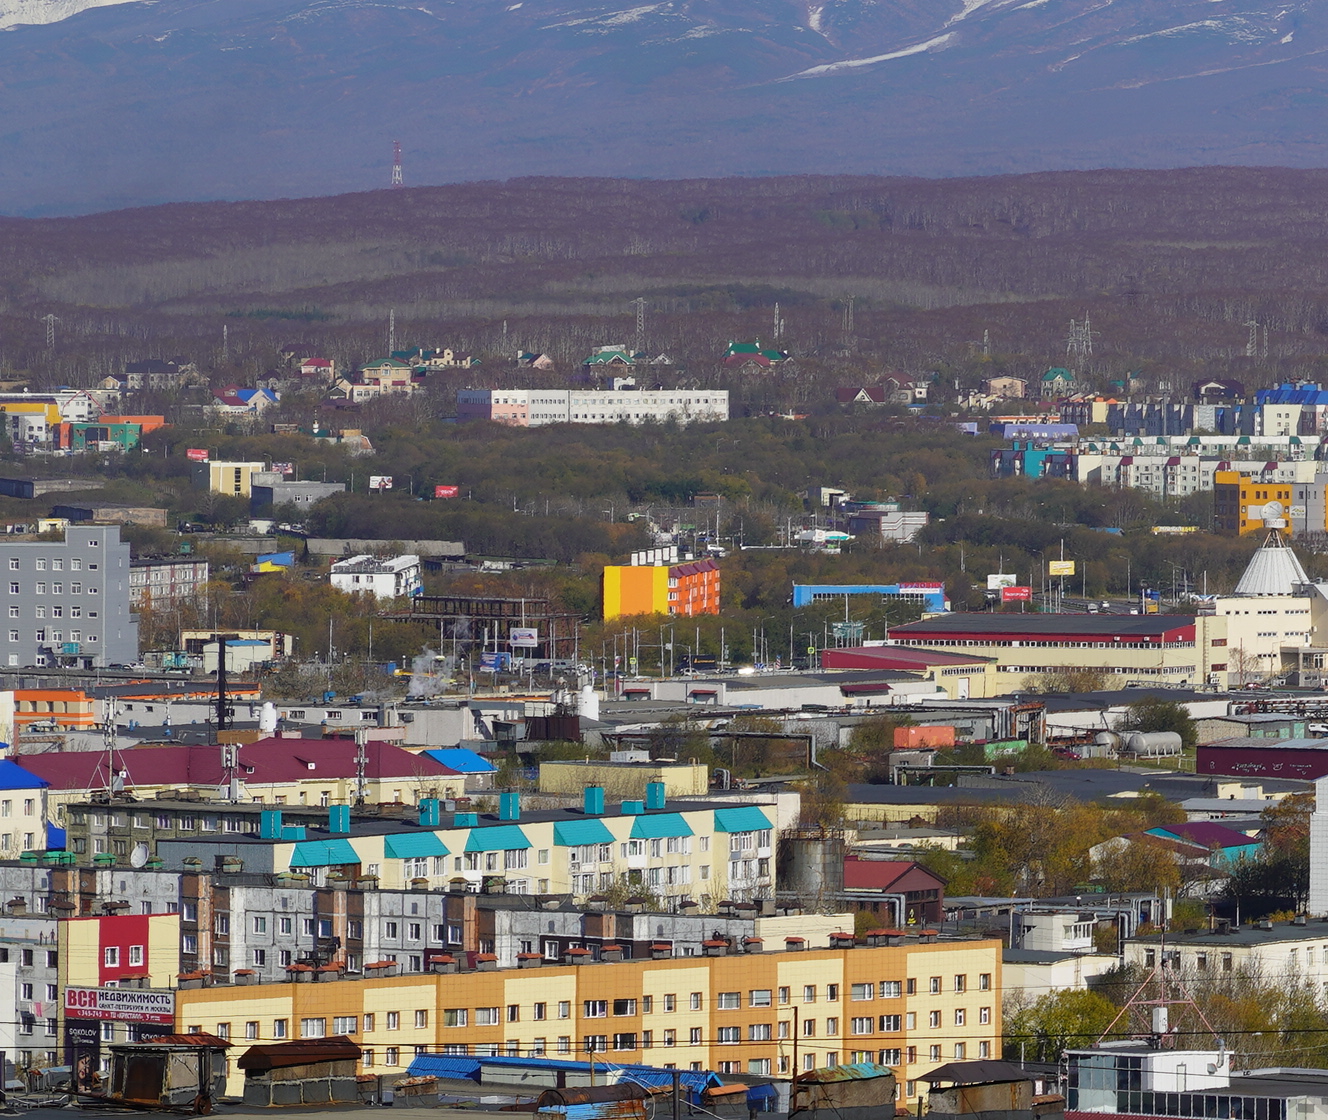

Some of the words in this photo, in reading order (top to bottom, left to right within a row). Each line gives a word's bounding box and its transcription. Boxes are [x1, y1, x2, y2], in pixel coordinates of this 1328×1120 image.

[67, 989, 97, 1008] ВСЯ
[98, 991, 171, 1004] НЕДВИЖИМОСТЬ
[69, 1028, 97, 1036] SOKOLOV
